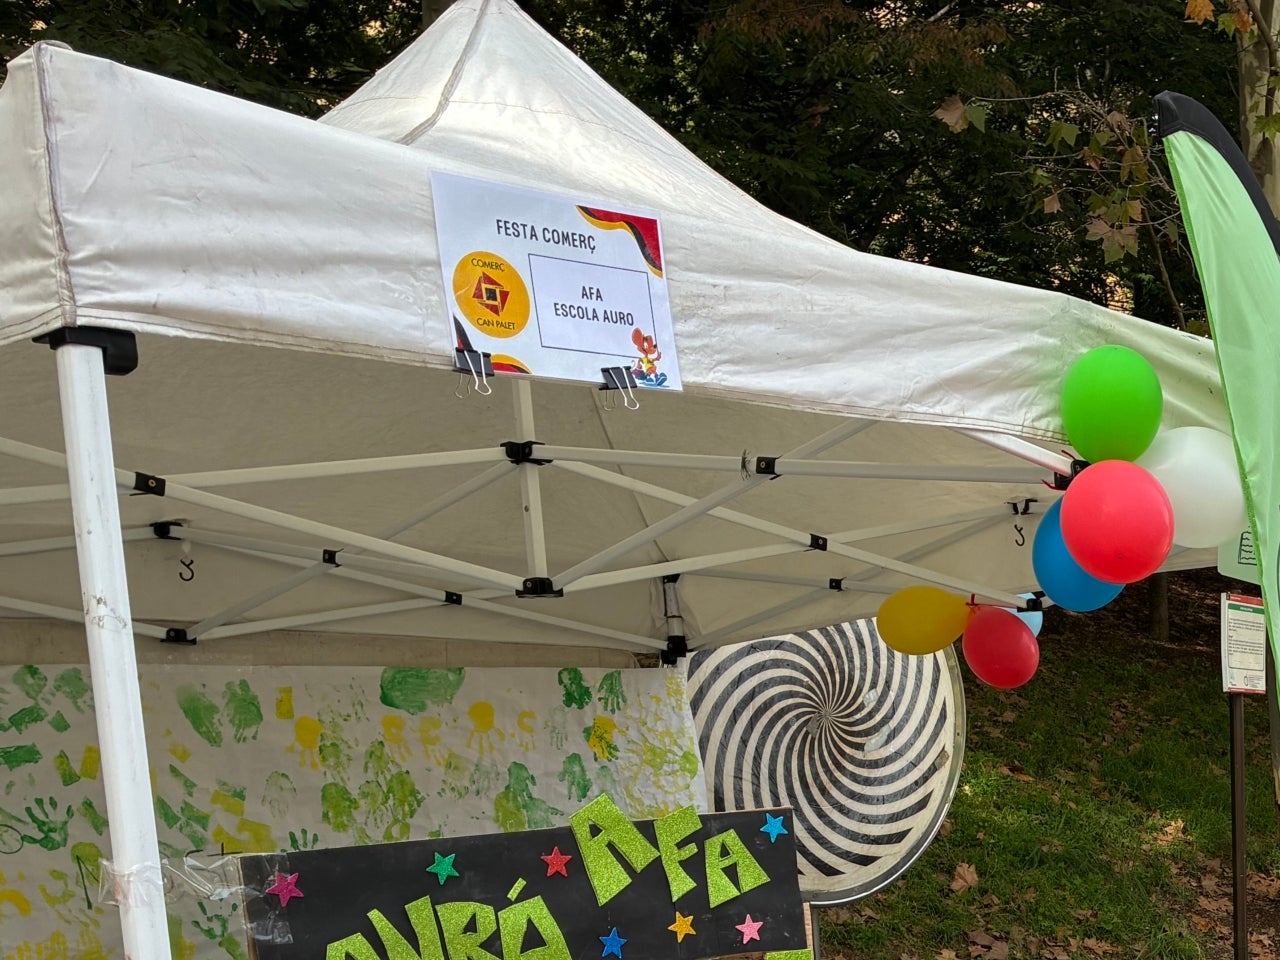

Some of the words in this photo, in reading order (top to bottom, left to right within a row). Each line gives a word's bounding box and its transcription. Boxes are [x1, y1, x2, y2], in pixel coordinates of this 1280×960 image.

[496, 219, 538, 241] FESTA
[542, 227, 596, 254] COMERÇ
[471, 258, 505, 272] COMERÇ
[581, 286, 603, 301] AFA
[477, 317, 495, 329] CAN
[495, 320, 516, 331] PALET
[554, 303, 600, 322] ESCOLA
[603, 311, 634, 326] AURO
[570, 793, 772, 909] AFA
